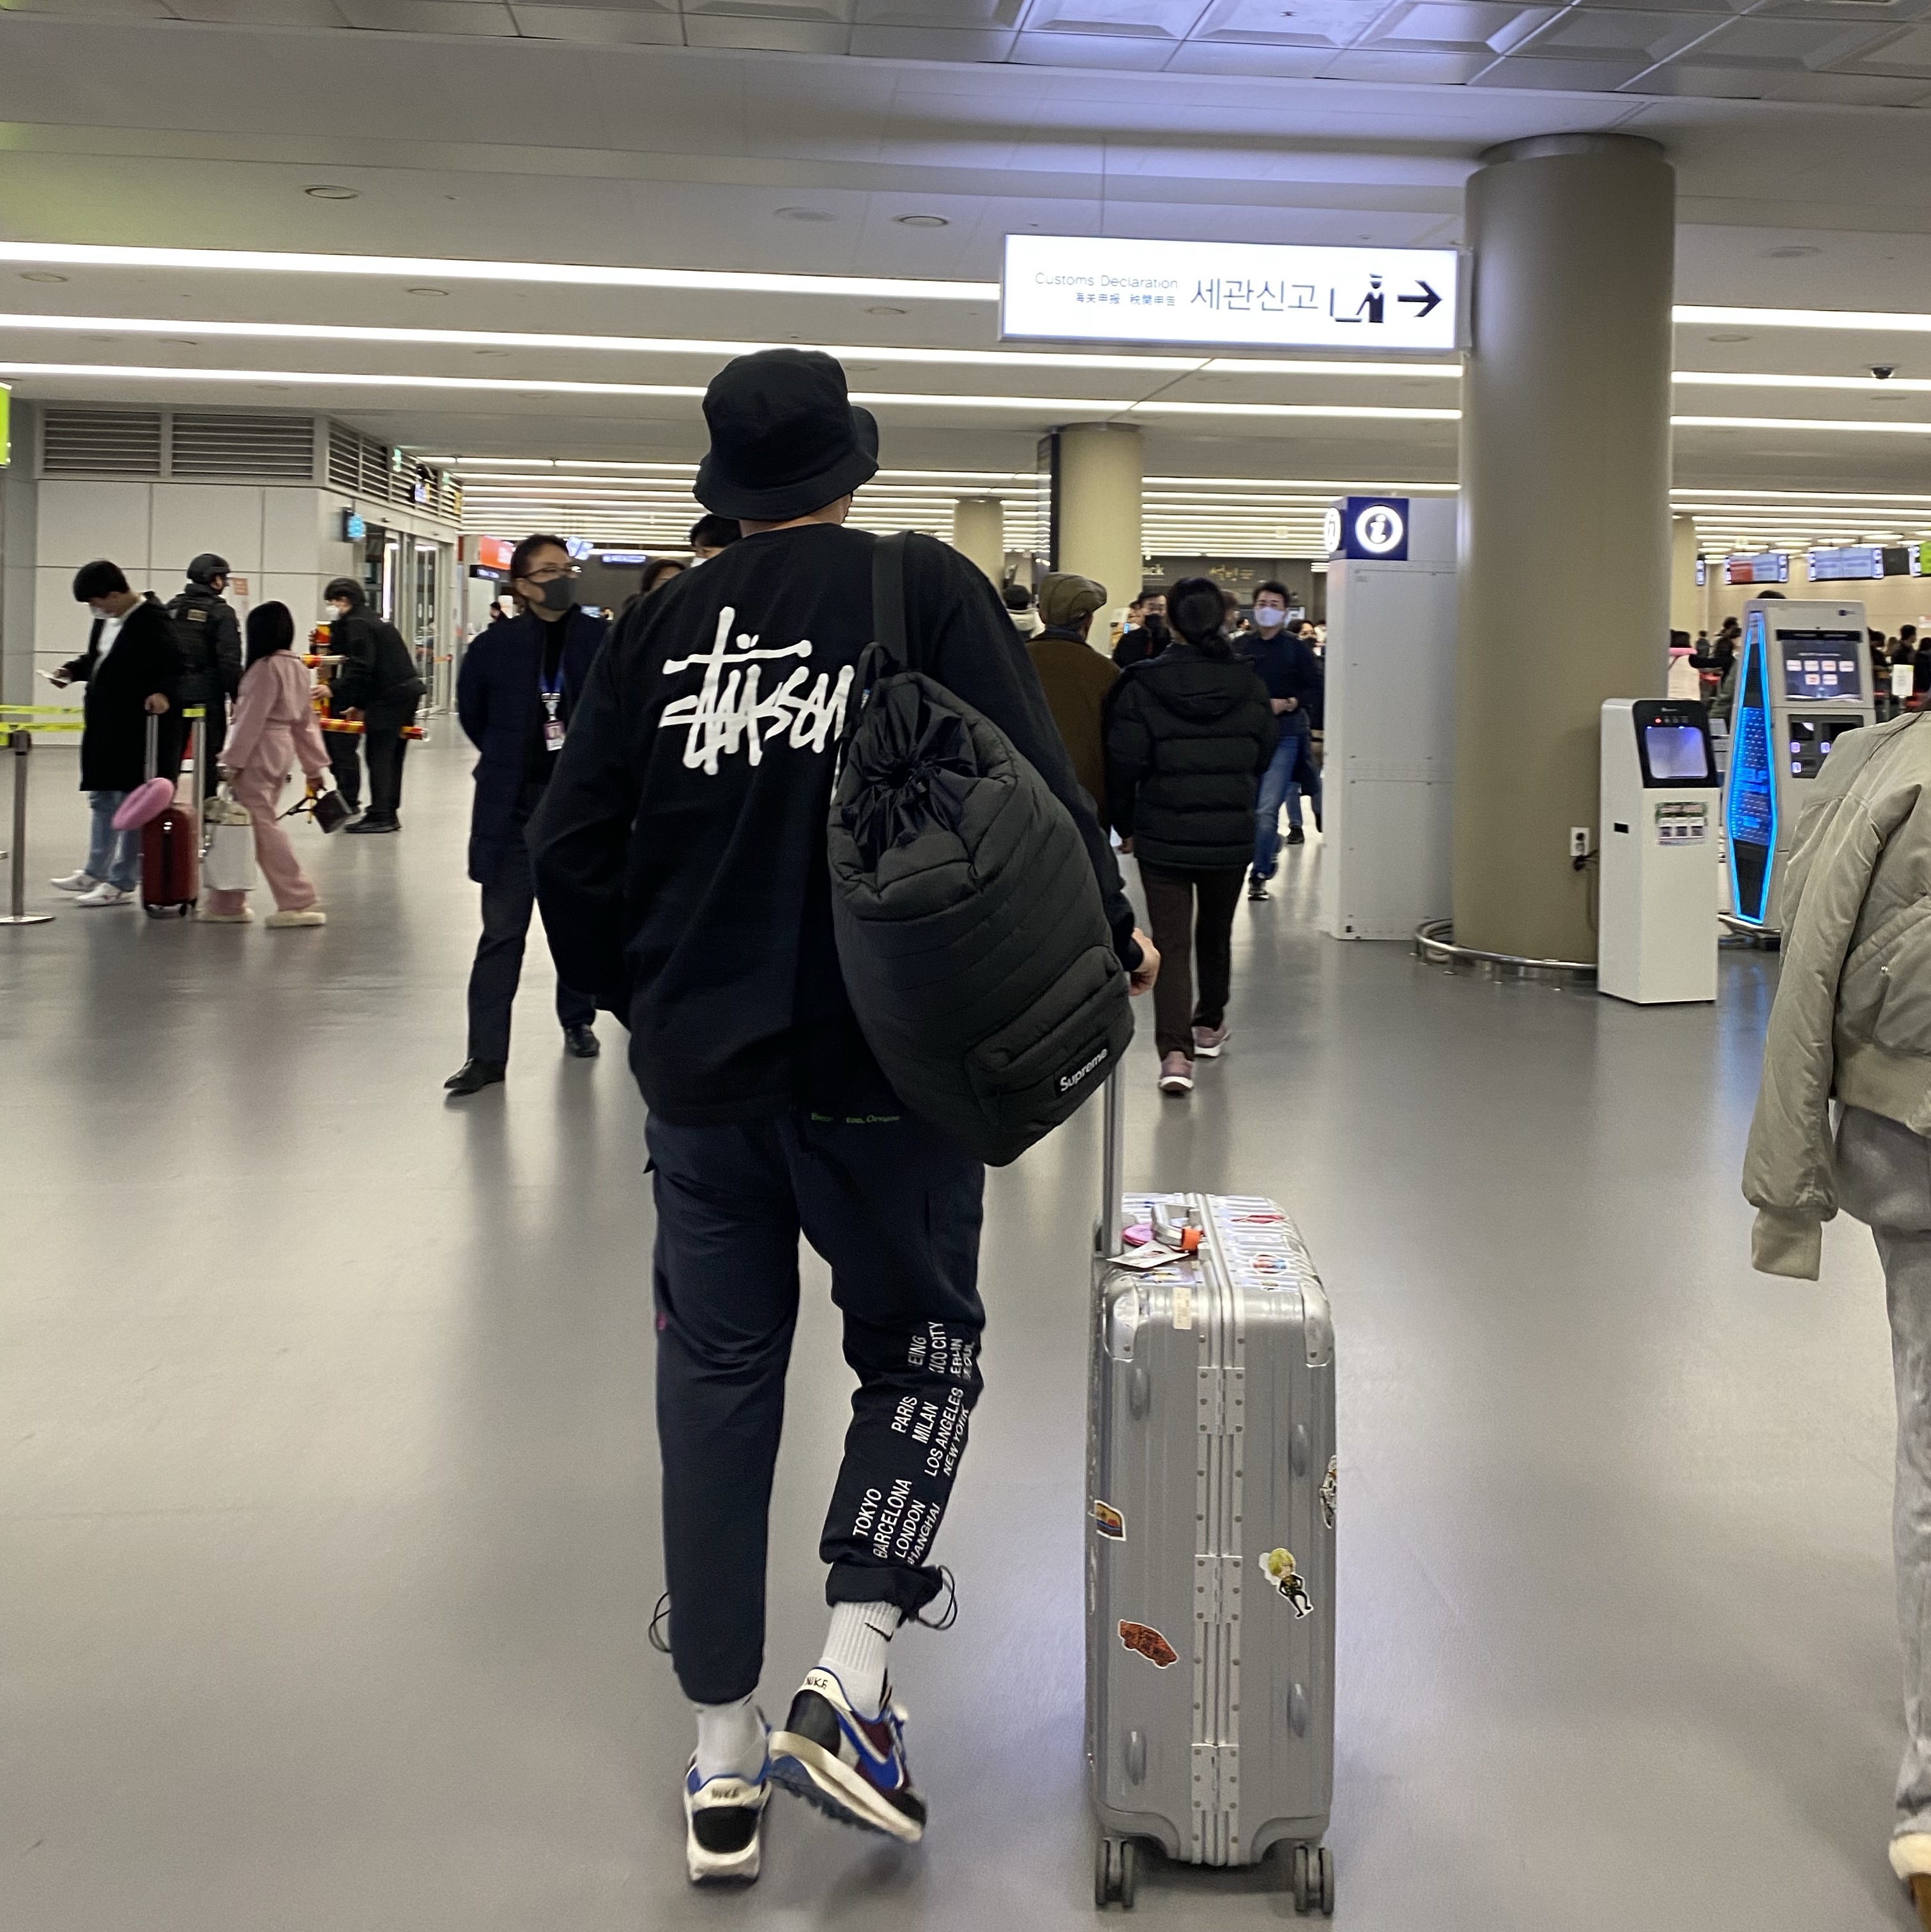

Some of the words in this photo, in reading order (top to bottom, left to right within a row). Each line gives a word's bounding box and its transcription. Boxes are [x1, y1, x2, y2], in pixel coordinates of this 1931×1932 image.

[1035, 272, 1095, 286] Customs
[1101, 275, 1178, 289] Declaration
[1190, 278, 1319, 311] 세관신고
[1059, 1048, 1108, 1092] Supreme
[927, 1321, 947, 1349] CITY
[890, 1396, 917, 1434] PARIS
[912, 1401, 938, 1444] MILAN
[924, 1448, 943, 1477] LOS
[935, 1387, 964, 1450] ANGELES
[943, 1442, 959, 1476] NEW
[953, 1403, 969, 1442] YORK
[852, 1488, 882, 1537] TOKYO
[873, 1479, 912, 1559] BARCELONA
[895, 1499, 926, 1558] LONDON
[805, 1676, 829, 1690] NIKE
